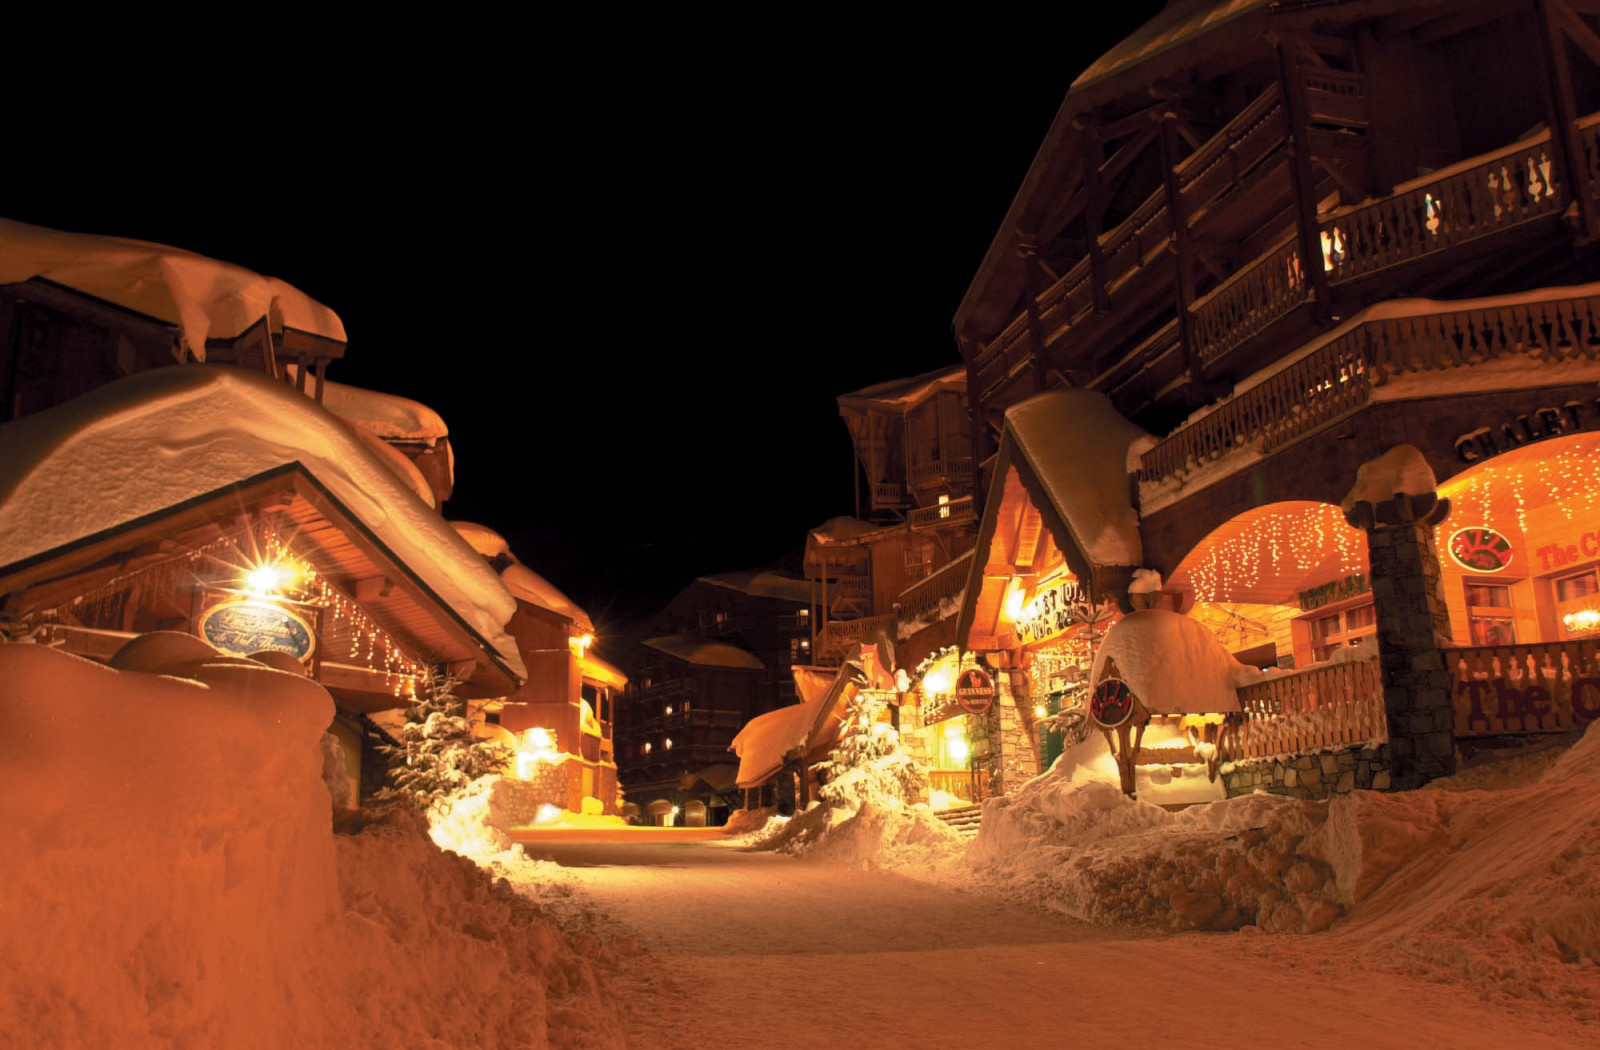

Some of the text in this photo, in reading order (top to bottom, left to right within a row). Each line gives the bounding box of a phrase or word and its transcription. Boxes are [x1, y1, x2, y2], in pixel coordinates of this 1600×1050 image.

[1454, 402, 1582, 464] CHALET
[1536, 529, 1600, 570] The C
[959, 688, 992, 696] GUINNESS
[1458, 679, 1551, 721] The
